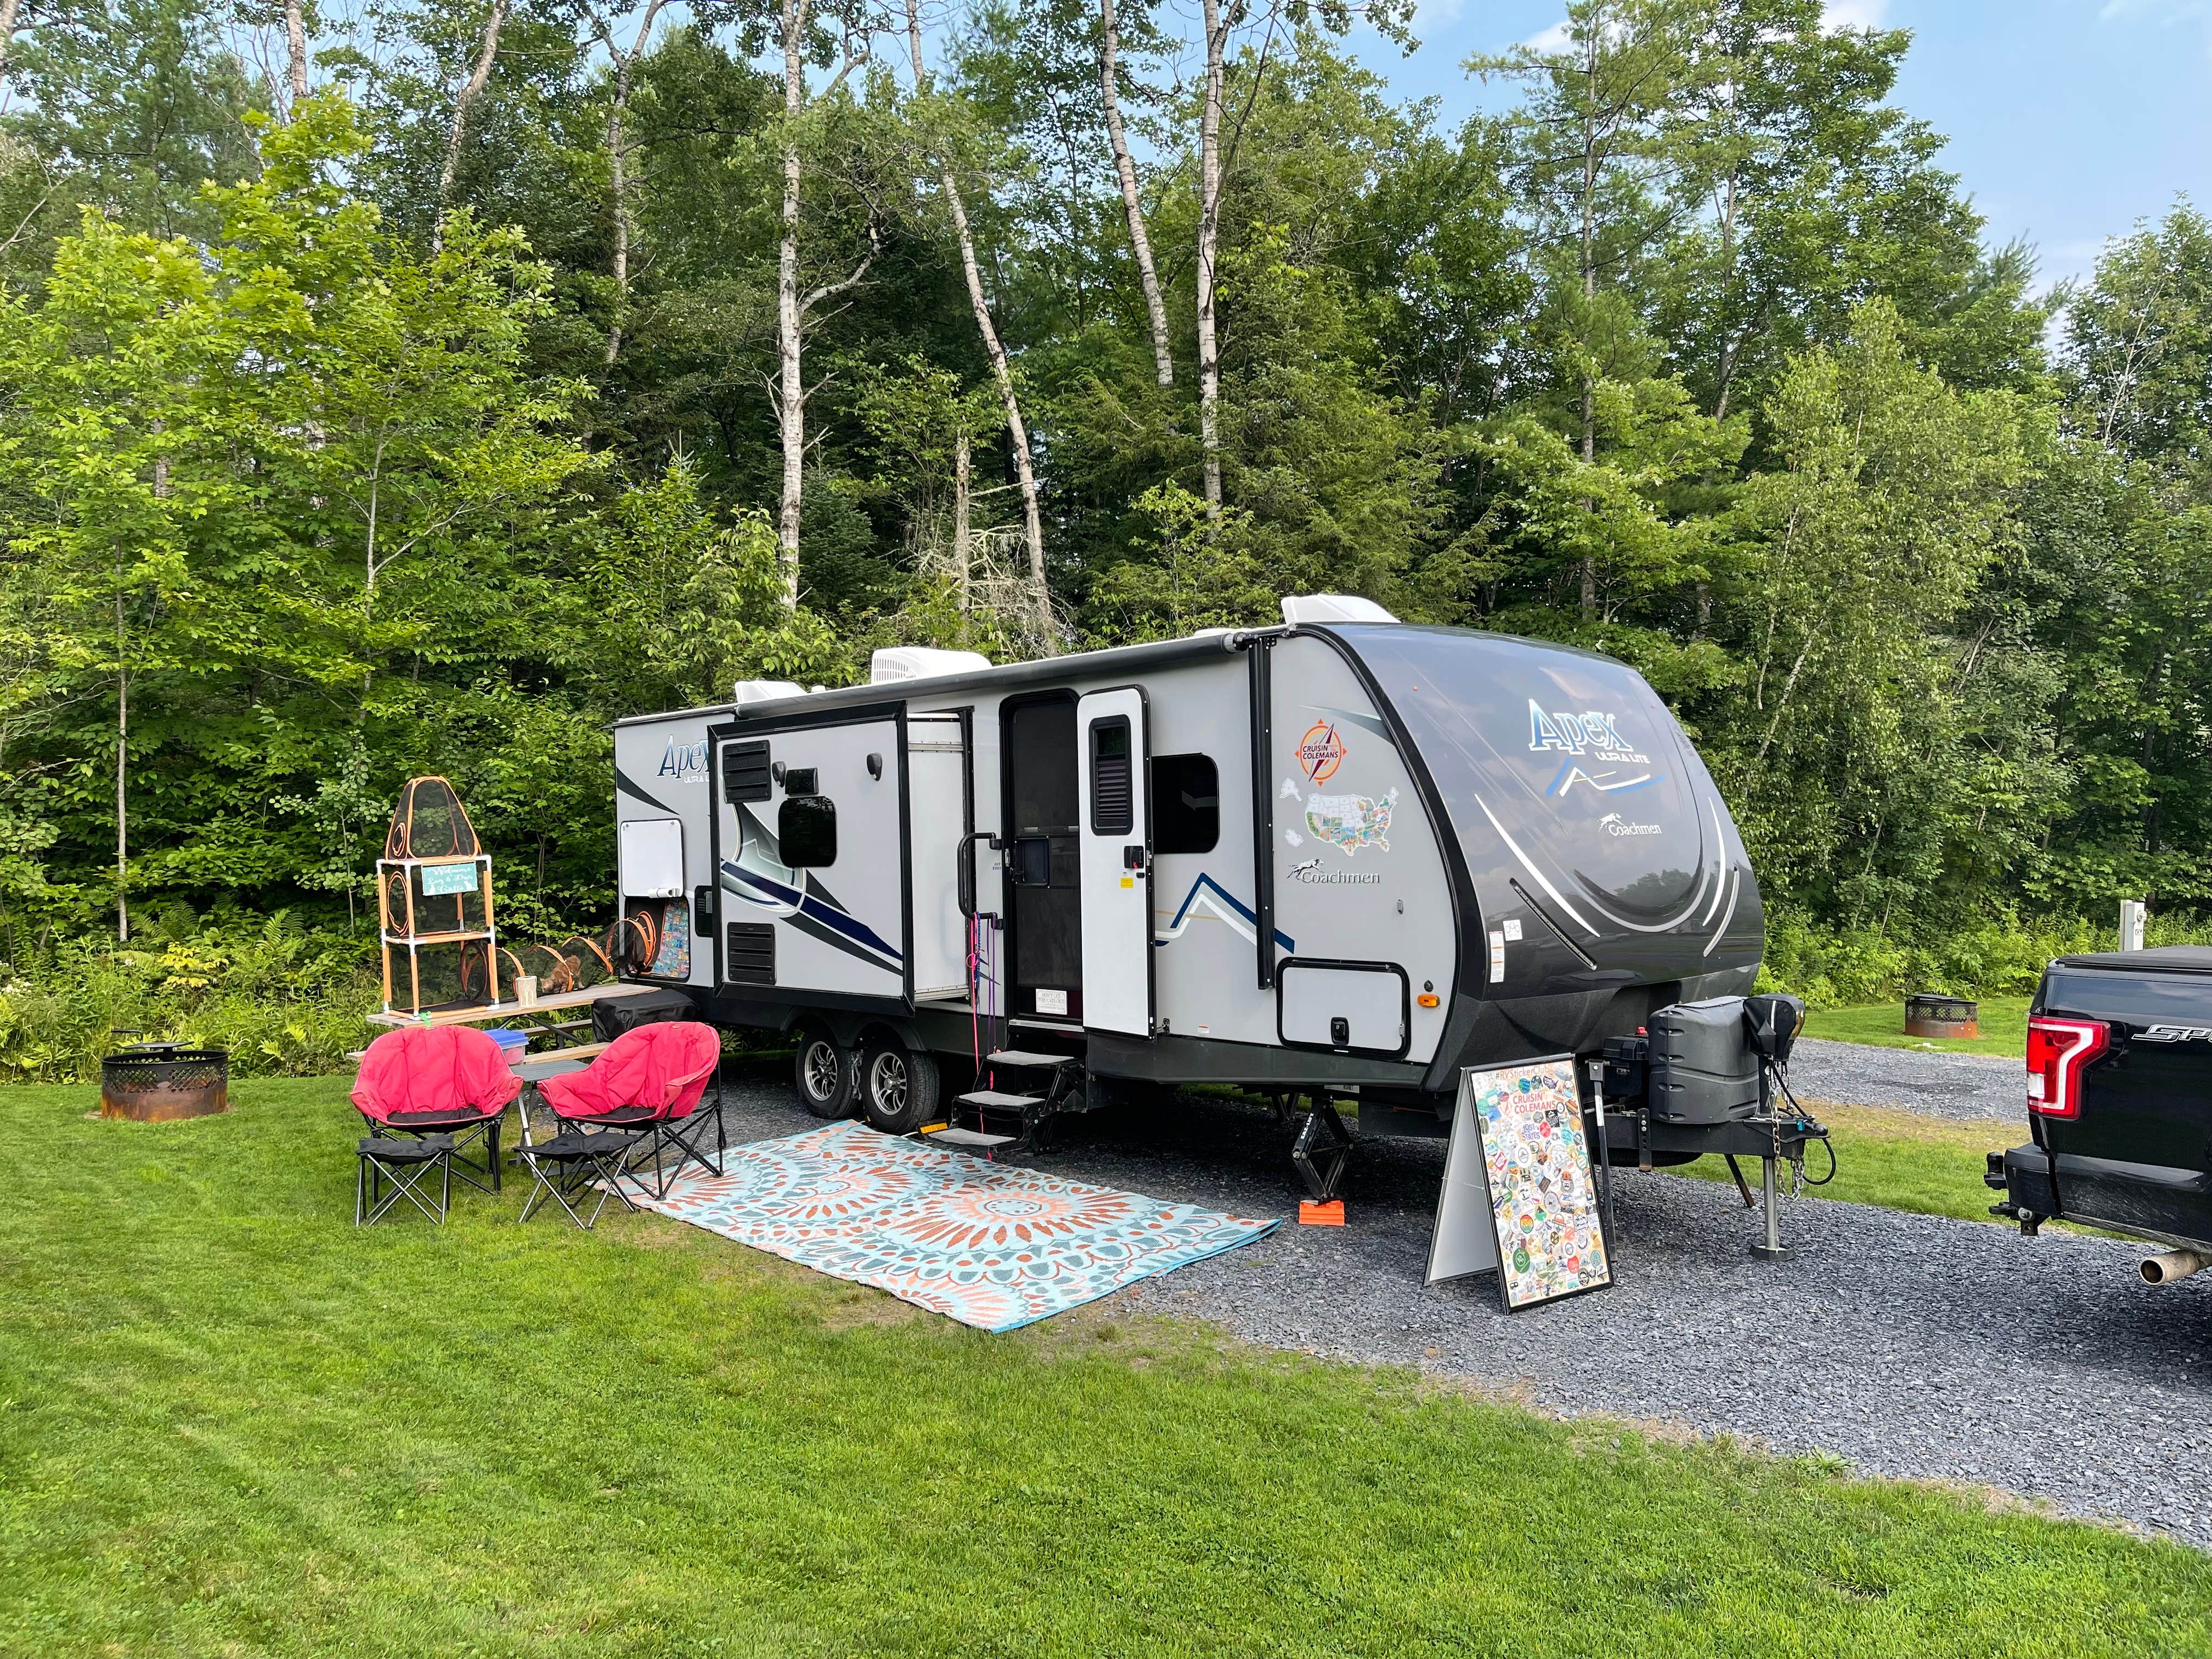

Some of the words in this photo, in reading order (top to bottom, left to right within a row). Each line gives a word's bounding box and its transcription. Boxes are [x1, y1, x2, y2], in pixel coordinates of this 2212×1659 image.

[1528, 698, 1634, 755] Apex
[1302, 751, 1338, 759] COLEMANS
[1595, 752, 1631, 763] ULTRA
[1630, 754, 1650, 764] LITE
[1609, 822, 1663, 837] Coachmen
[1301, 870, 1381, 884] Coachmen
[1514, 1101, 1557, 1114] COLEMANS
